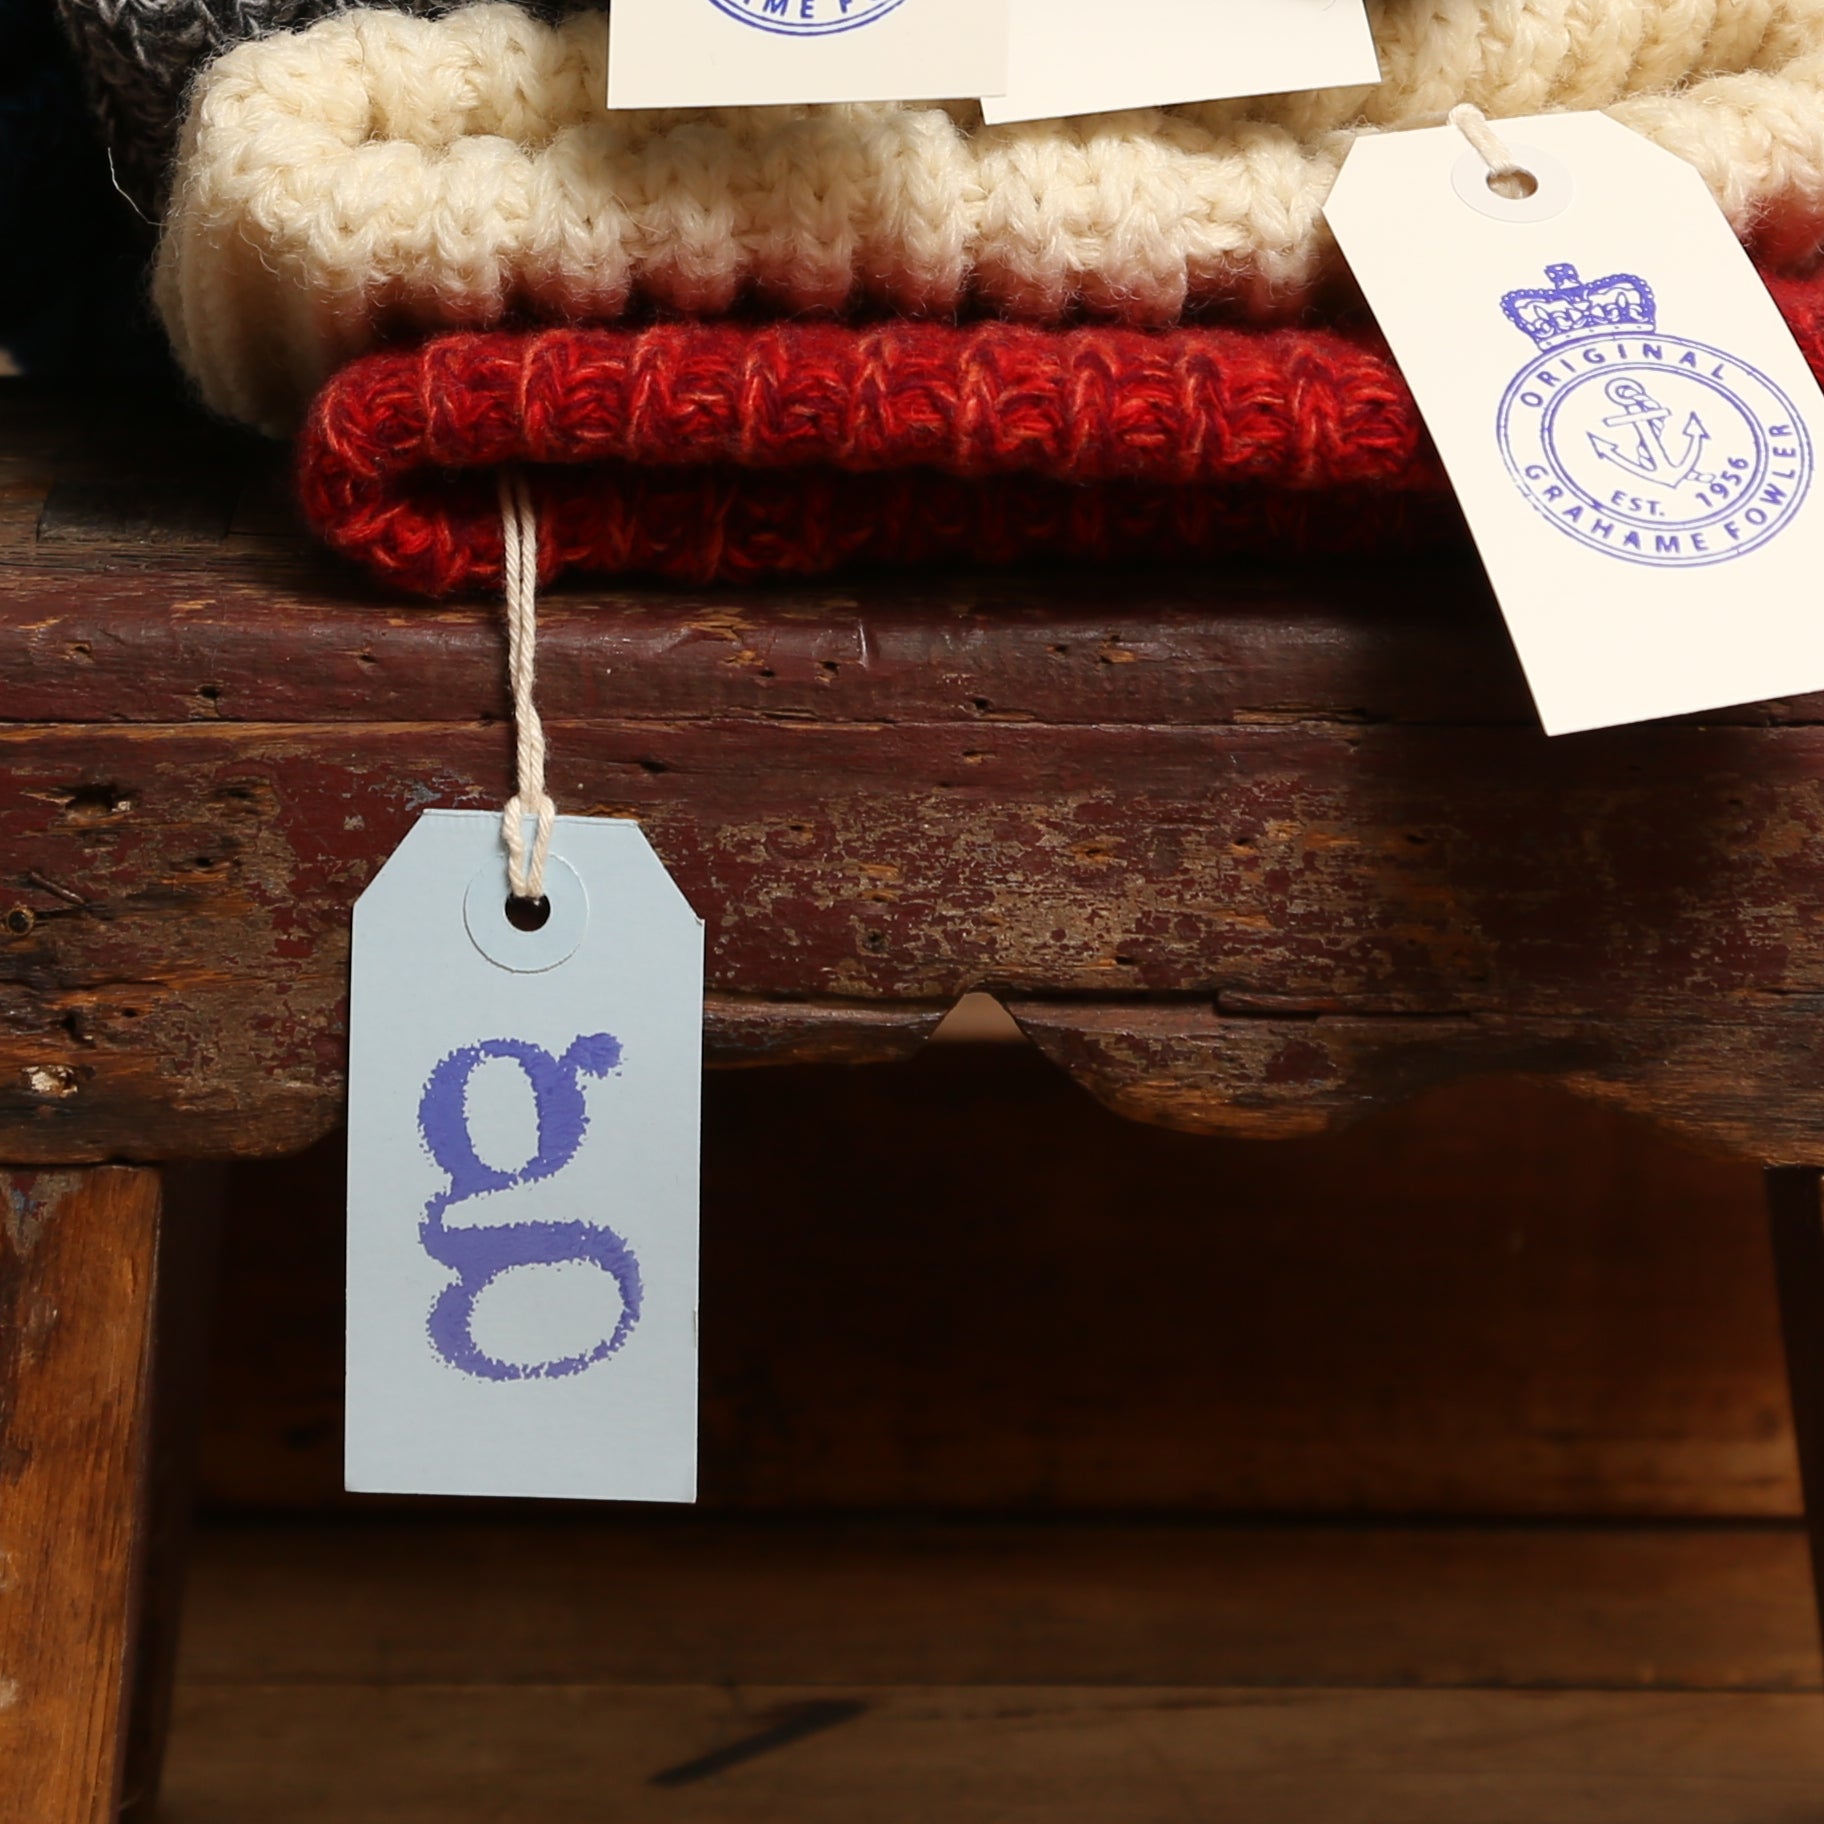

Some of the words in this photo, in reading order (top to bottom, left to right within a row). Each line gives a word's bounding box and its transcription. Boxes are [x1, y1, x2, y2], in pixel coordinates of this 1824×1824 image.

[1520, 343, 1724, 408] ORIGINAL
[1525, 465, 1708, 553] GRAHAME
[1723, 424, 1797, 541] FOWLER
[1610, 490, 1665, 517] EST.
[1695, 457, 1750, 508] 1956
[417, 1032, 643, 1382] g
